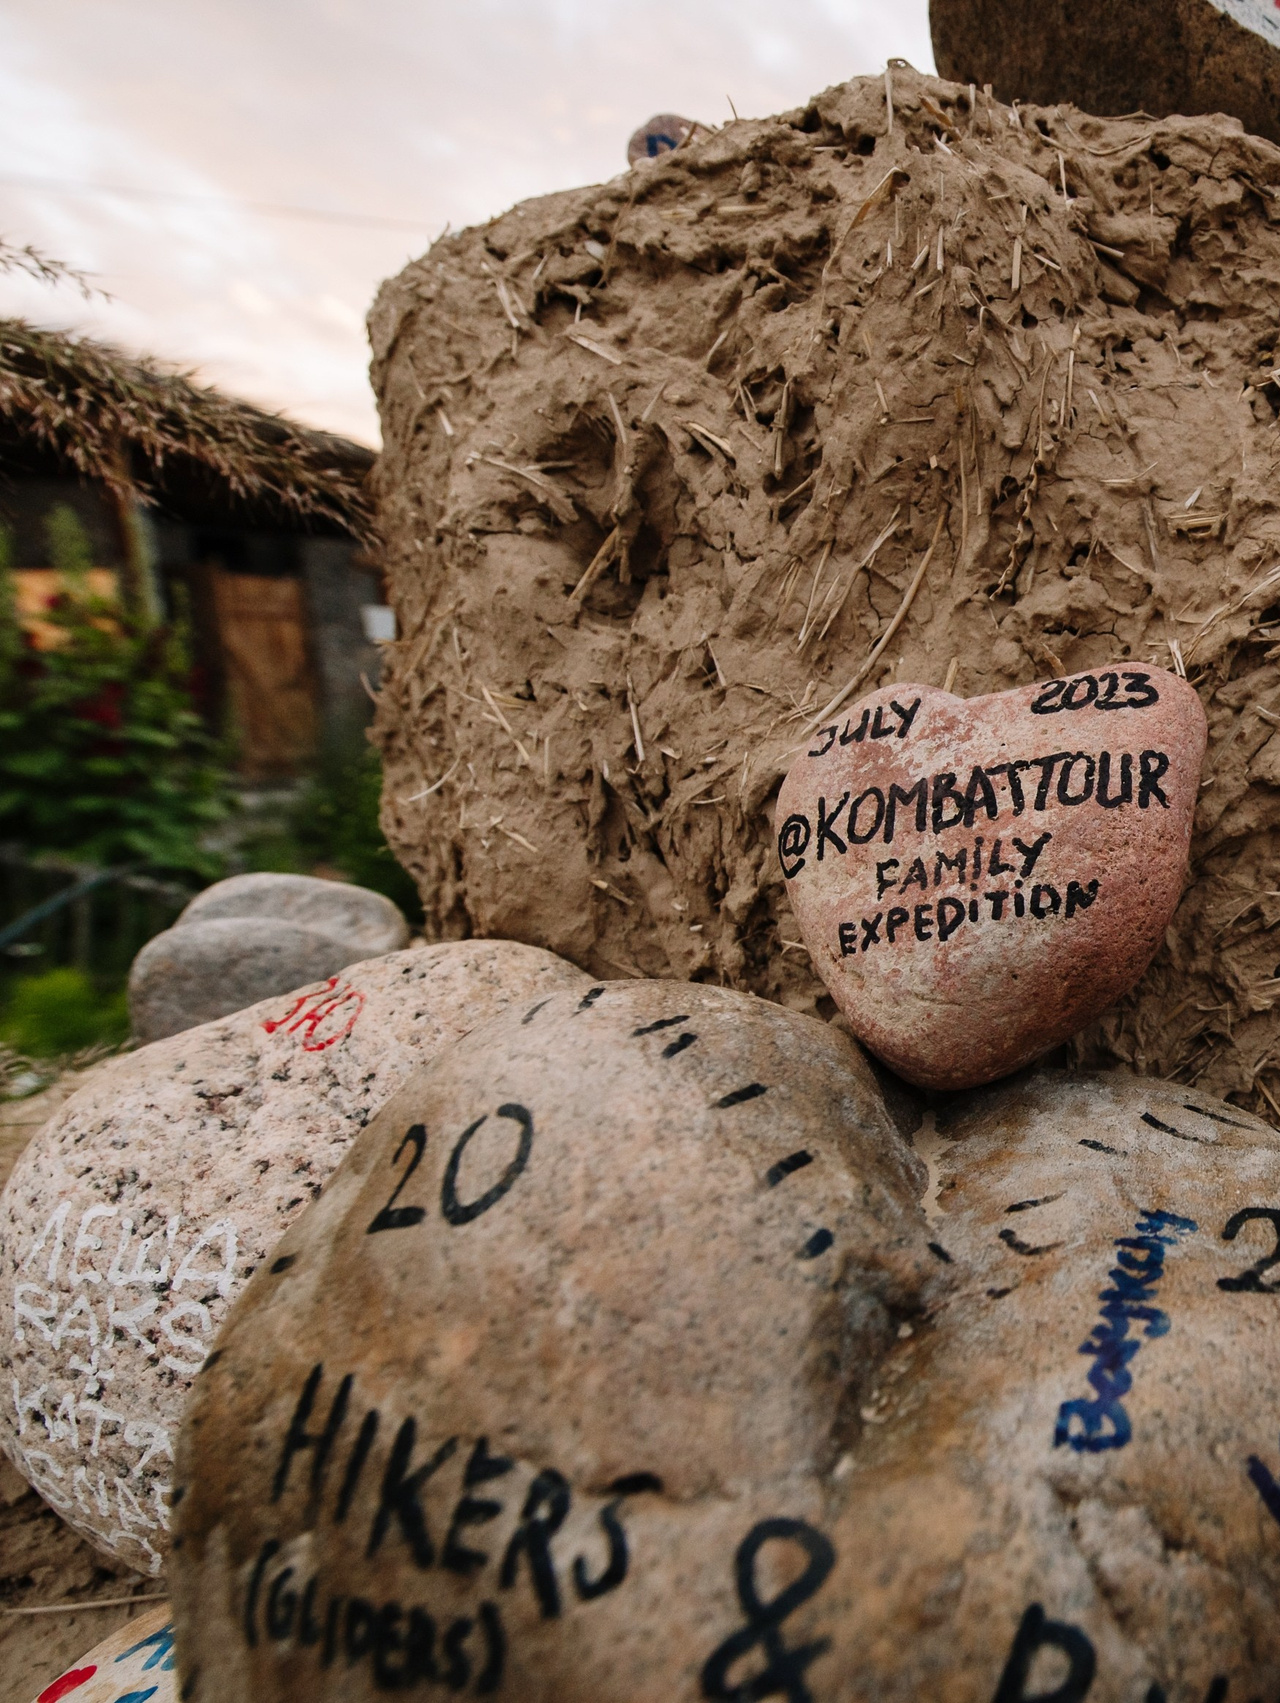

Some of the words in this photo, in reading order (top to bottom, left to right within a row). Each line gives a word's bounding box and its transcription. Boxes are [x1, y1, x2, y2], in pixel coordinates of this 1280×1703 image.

[808, 698, 922, 757] JULY
[1030, 671, 1160, 715] 2023
[876, 832, 1053, 900] FAMILY
[368, 1102, 533, 1234] 20
[272, 1362, 664, 1620] HIKERS
